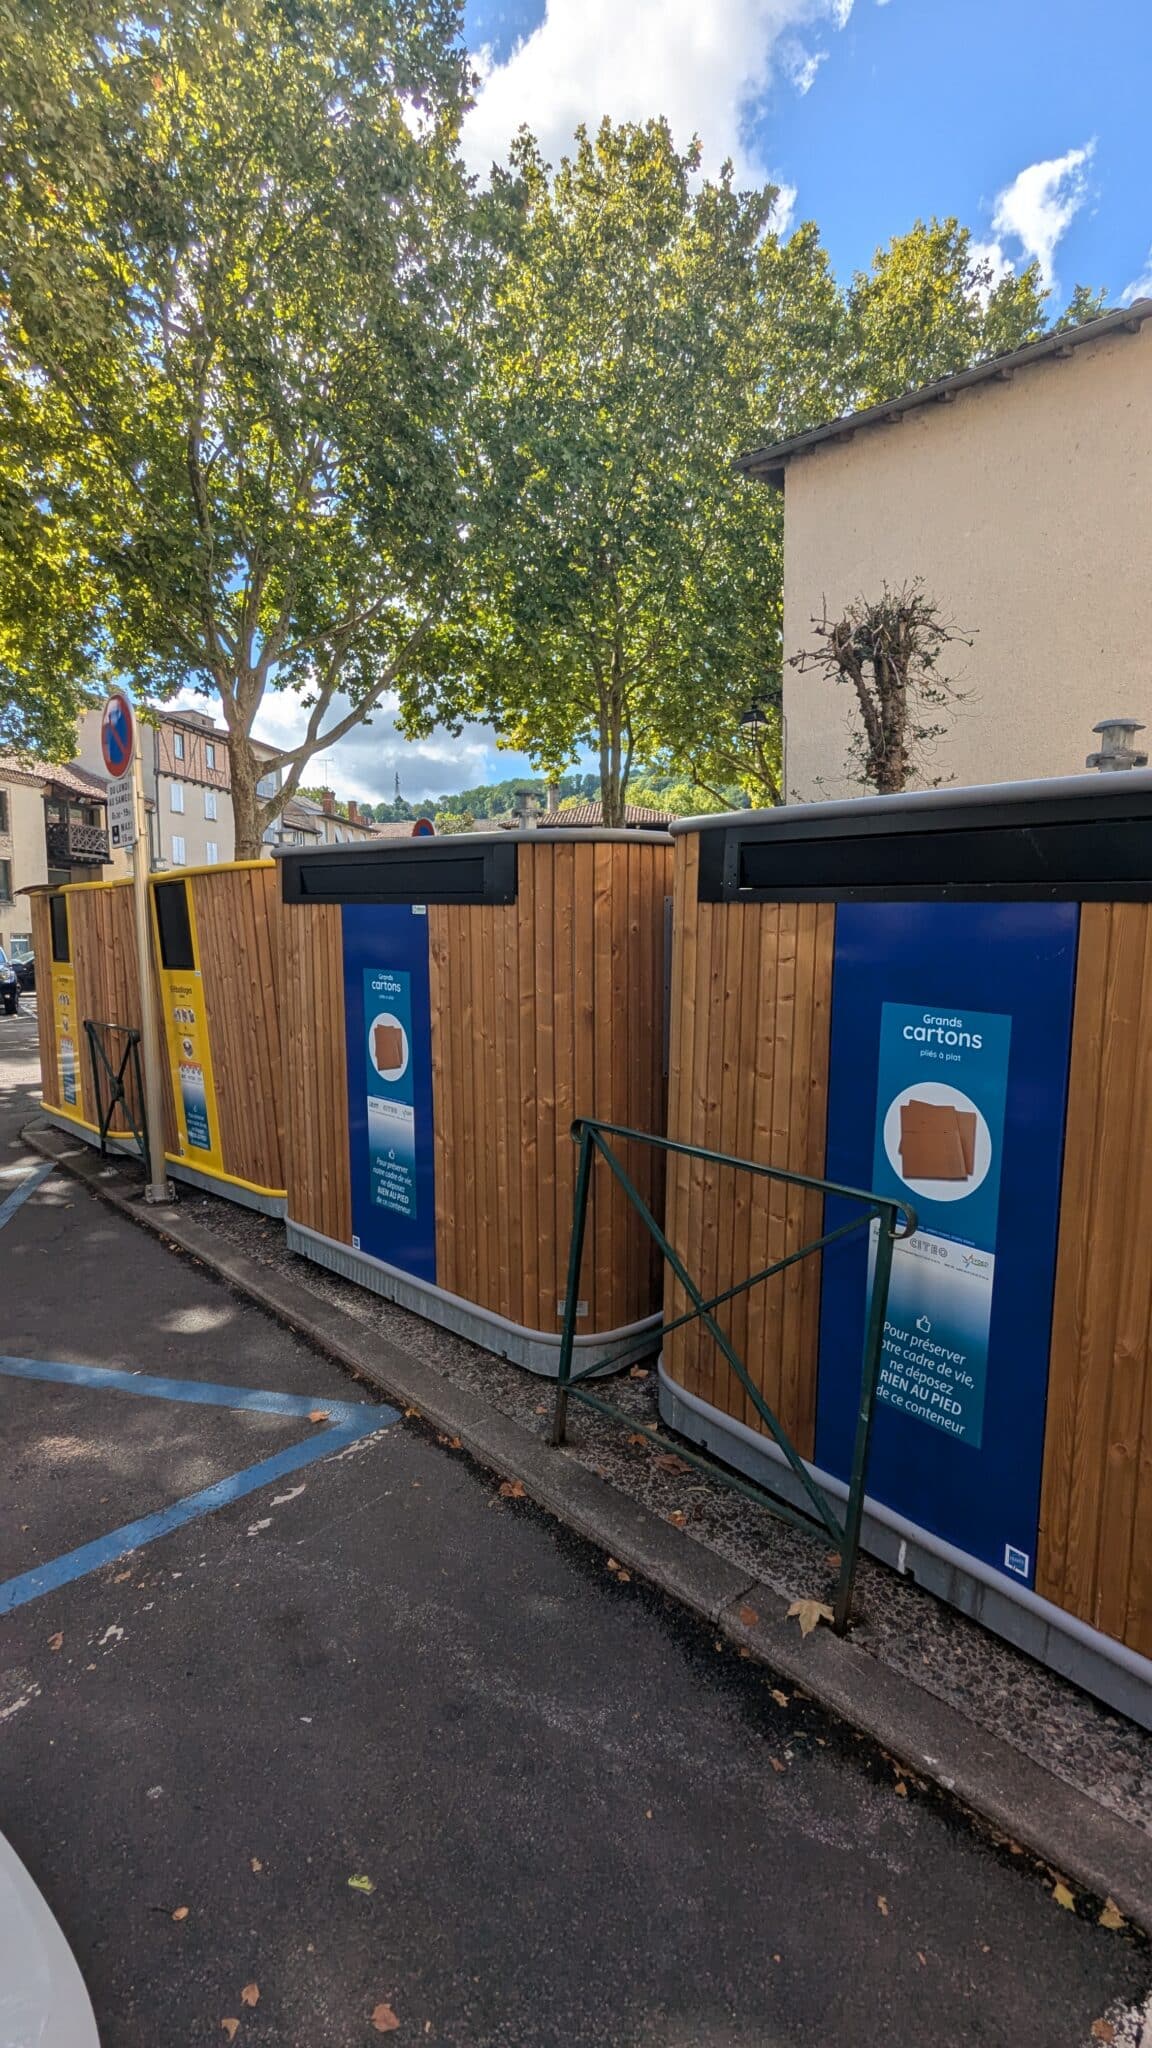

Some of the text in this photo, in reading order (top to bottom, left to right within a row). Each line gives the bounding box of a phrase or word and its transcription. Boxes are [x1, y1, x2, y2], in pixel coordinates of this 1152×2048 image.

[371, 981, 402, 992] cartons
[922, 1013, 963, 1028] Grands
[903, 1025, 983, 1049] cartons
[920, 1049, 961, 1062] pliés à plat
[396, 1193, 410, 1204] PIED
[909, 1237, 948, 1258] CITEO
[883, 1321, 967, 1365] Pour préserver
[881, 1338, 975, 1389] otre cadre de vie,
[889, 1360, 954, 1396] ne déposez
[880, 1369, 962, 1416] RIEN AU PIED
[875, 1384, 966, 1435] de ce conteneur
